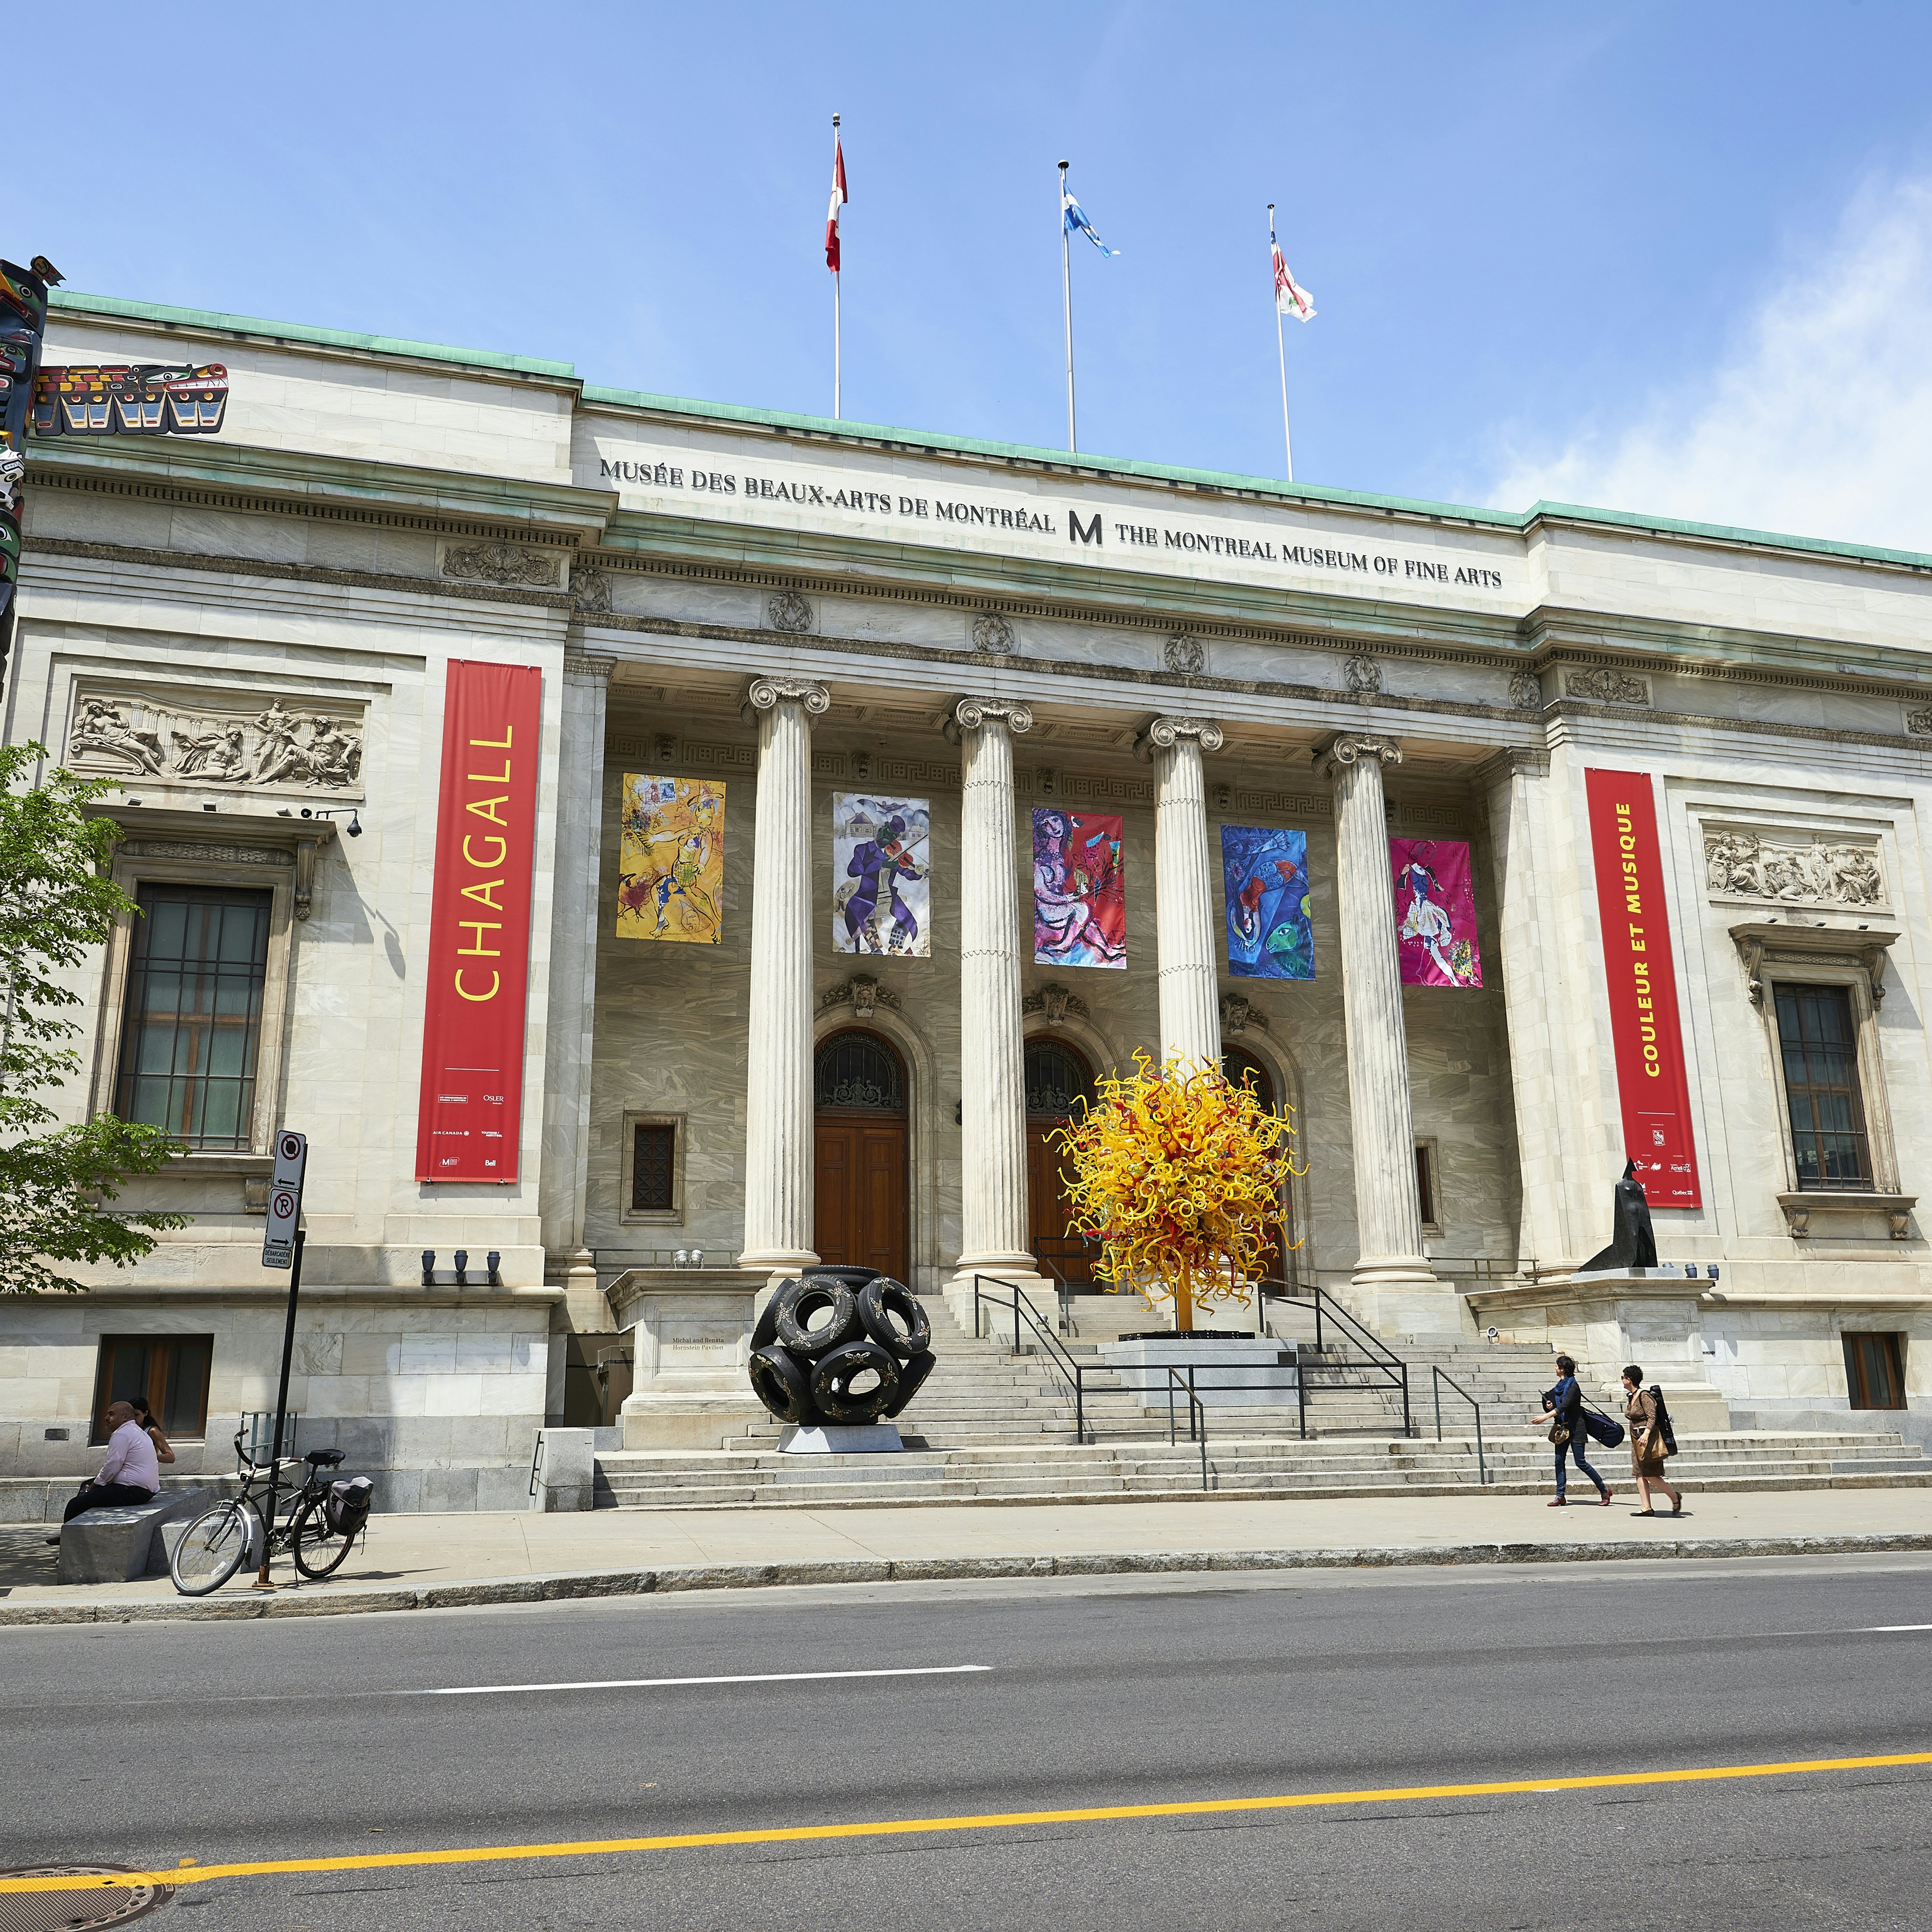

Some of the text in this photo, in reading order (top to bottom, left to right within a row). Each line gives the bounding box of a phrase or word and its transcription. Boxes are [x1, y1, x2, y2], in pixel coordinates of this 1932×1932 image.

[600, 459, 1502, 587] MUSÉE DES BEAUX-ARTS DE MONTRÉAL M THE MONTREAL MUSEUM OF FINE ARTS
[454, 725, 513, 1001] CHAGALL
[1616, 803, 1661, 1077] COULEUR ET MUSIQUE
[265, 1249, 291, 1258] DÉBARCADÈRE
